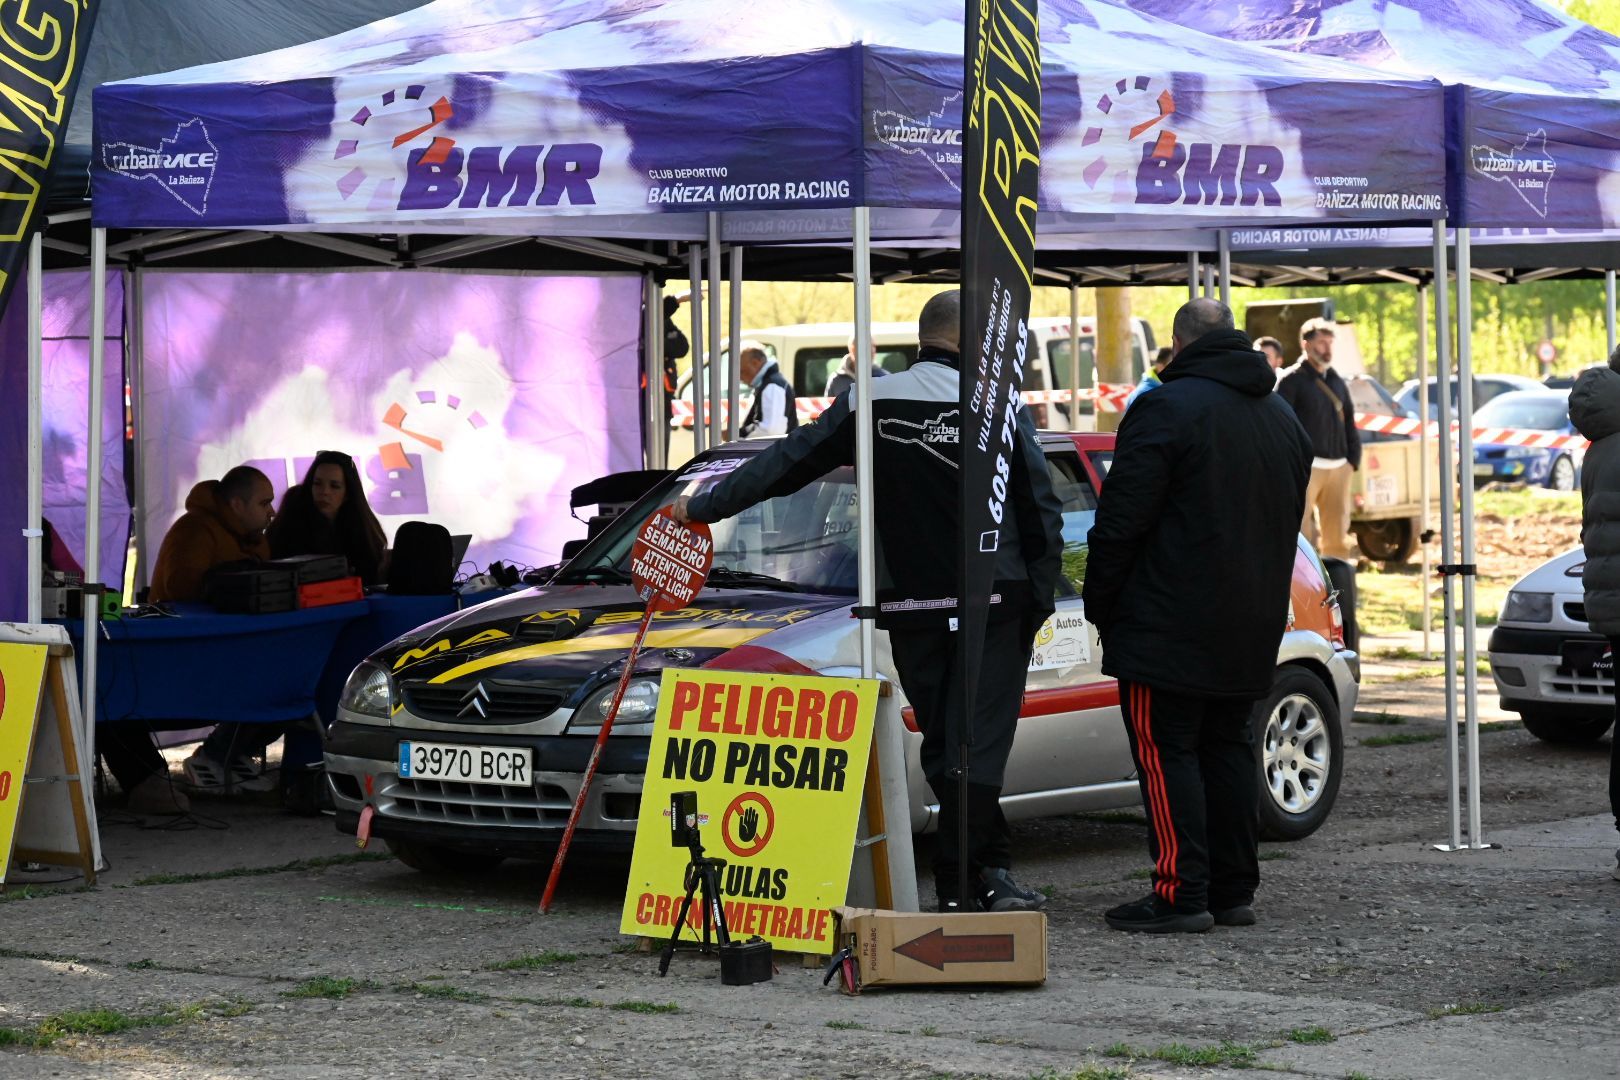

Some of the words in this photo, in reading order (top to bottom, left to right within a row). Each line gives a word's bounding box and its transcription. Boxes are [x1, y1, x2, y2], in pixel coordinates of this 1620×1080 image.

[169, 175, 178, 185] La
[179, 174, 205, 185] Bañeza
[397, 143, 603, 211] BMR
[649, 169, 673, 179] CLUB
[675, 167, 728, 179] DEPORTIVO
[936, 152, 945, 163] La
[946, 152, 962, 164] Bañe
[1135, 141, 1284, 206] BMR
[648, 182, 715, 204] BAÑEZA
[720, 183, 780, 202] MOTOR
[784, 180, 850, 200] RACING
[1314, 176, 1331, 186] CLUB
[1332, 176, 1368, 187] DEPORTIVO
[1316, 189, 1359, 209] BAÑEZA
[1361, 193, 1400, 209] MOTOR
[1401, 194, 1441, 210] RACING
[997, 288, 1012, 352] ORBIGO
[970, 379, 985, 414] Ctra.
[978, 356, 988, 376] La
[983, 303, 997, 354] Bañeza
[992, 351, 1003, 379] DE
[977, 379, 999, 452] VILLORIA
[988, 453, 1010, 524] 608
[1001, 382, 1020, 452] 775
[1013, 318, 1028, 384] 148
[643, 549, 692, 585] ATTENTION
[644, 526, 706, 569] SEMAFORO
[631, 558, 667, 588] TRAFFIC
[665, 578, 694, 602] LIGHT
[1056, 617, 1083, 630] Autos
[668, 681, 859, 743] PELIGRO
[414, 747, 472, 778] 3970
[480, 748, 525, 781] BCR
[662, 737, 717, 783] NO
[723, 741, 849, 792] PASAR
[636, 893, 829, 941] CRONMETRAJE
